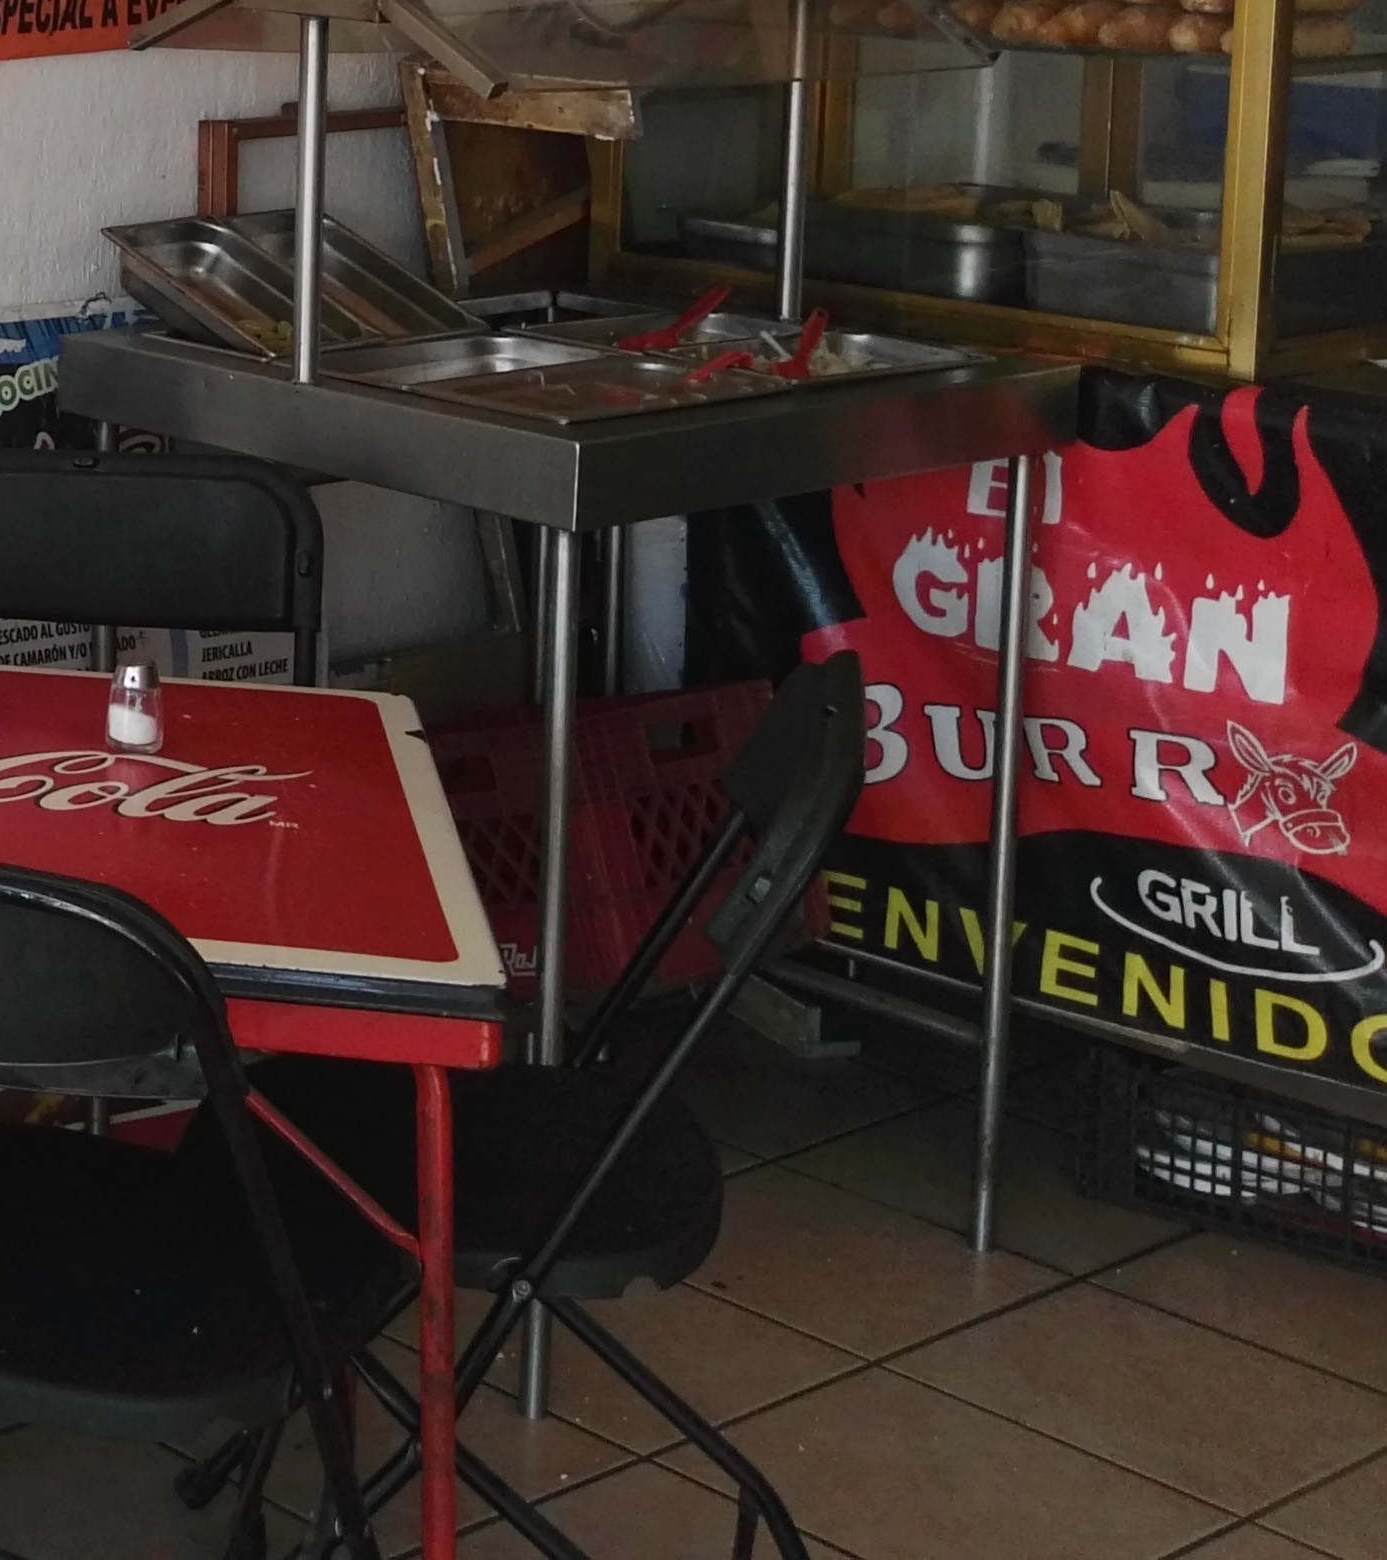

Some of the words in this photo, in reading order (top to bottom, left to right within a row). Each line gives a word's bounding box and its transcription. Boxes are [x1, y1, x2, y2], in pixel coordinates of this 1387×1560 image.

[891, 527, 1290, 706] GRAN
[40, 623, 55, 639] AL
[13, 643, 67, 666] CAMARÓN
[201, 641, 253, 664] JERICALLA
[236, 663, 256, 681] CON
[258, 658, 289, 677] LECHE
[1136, 868, 1321, 957] GRILL
